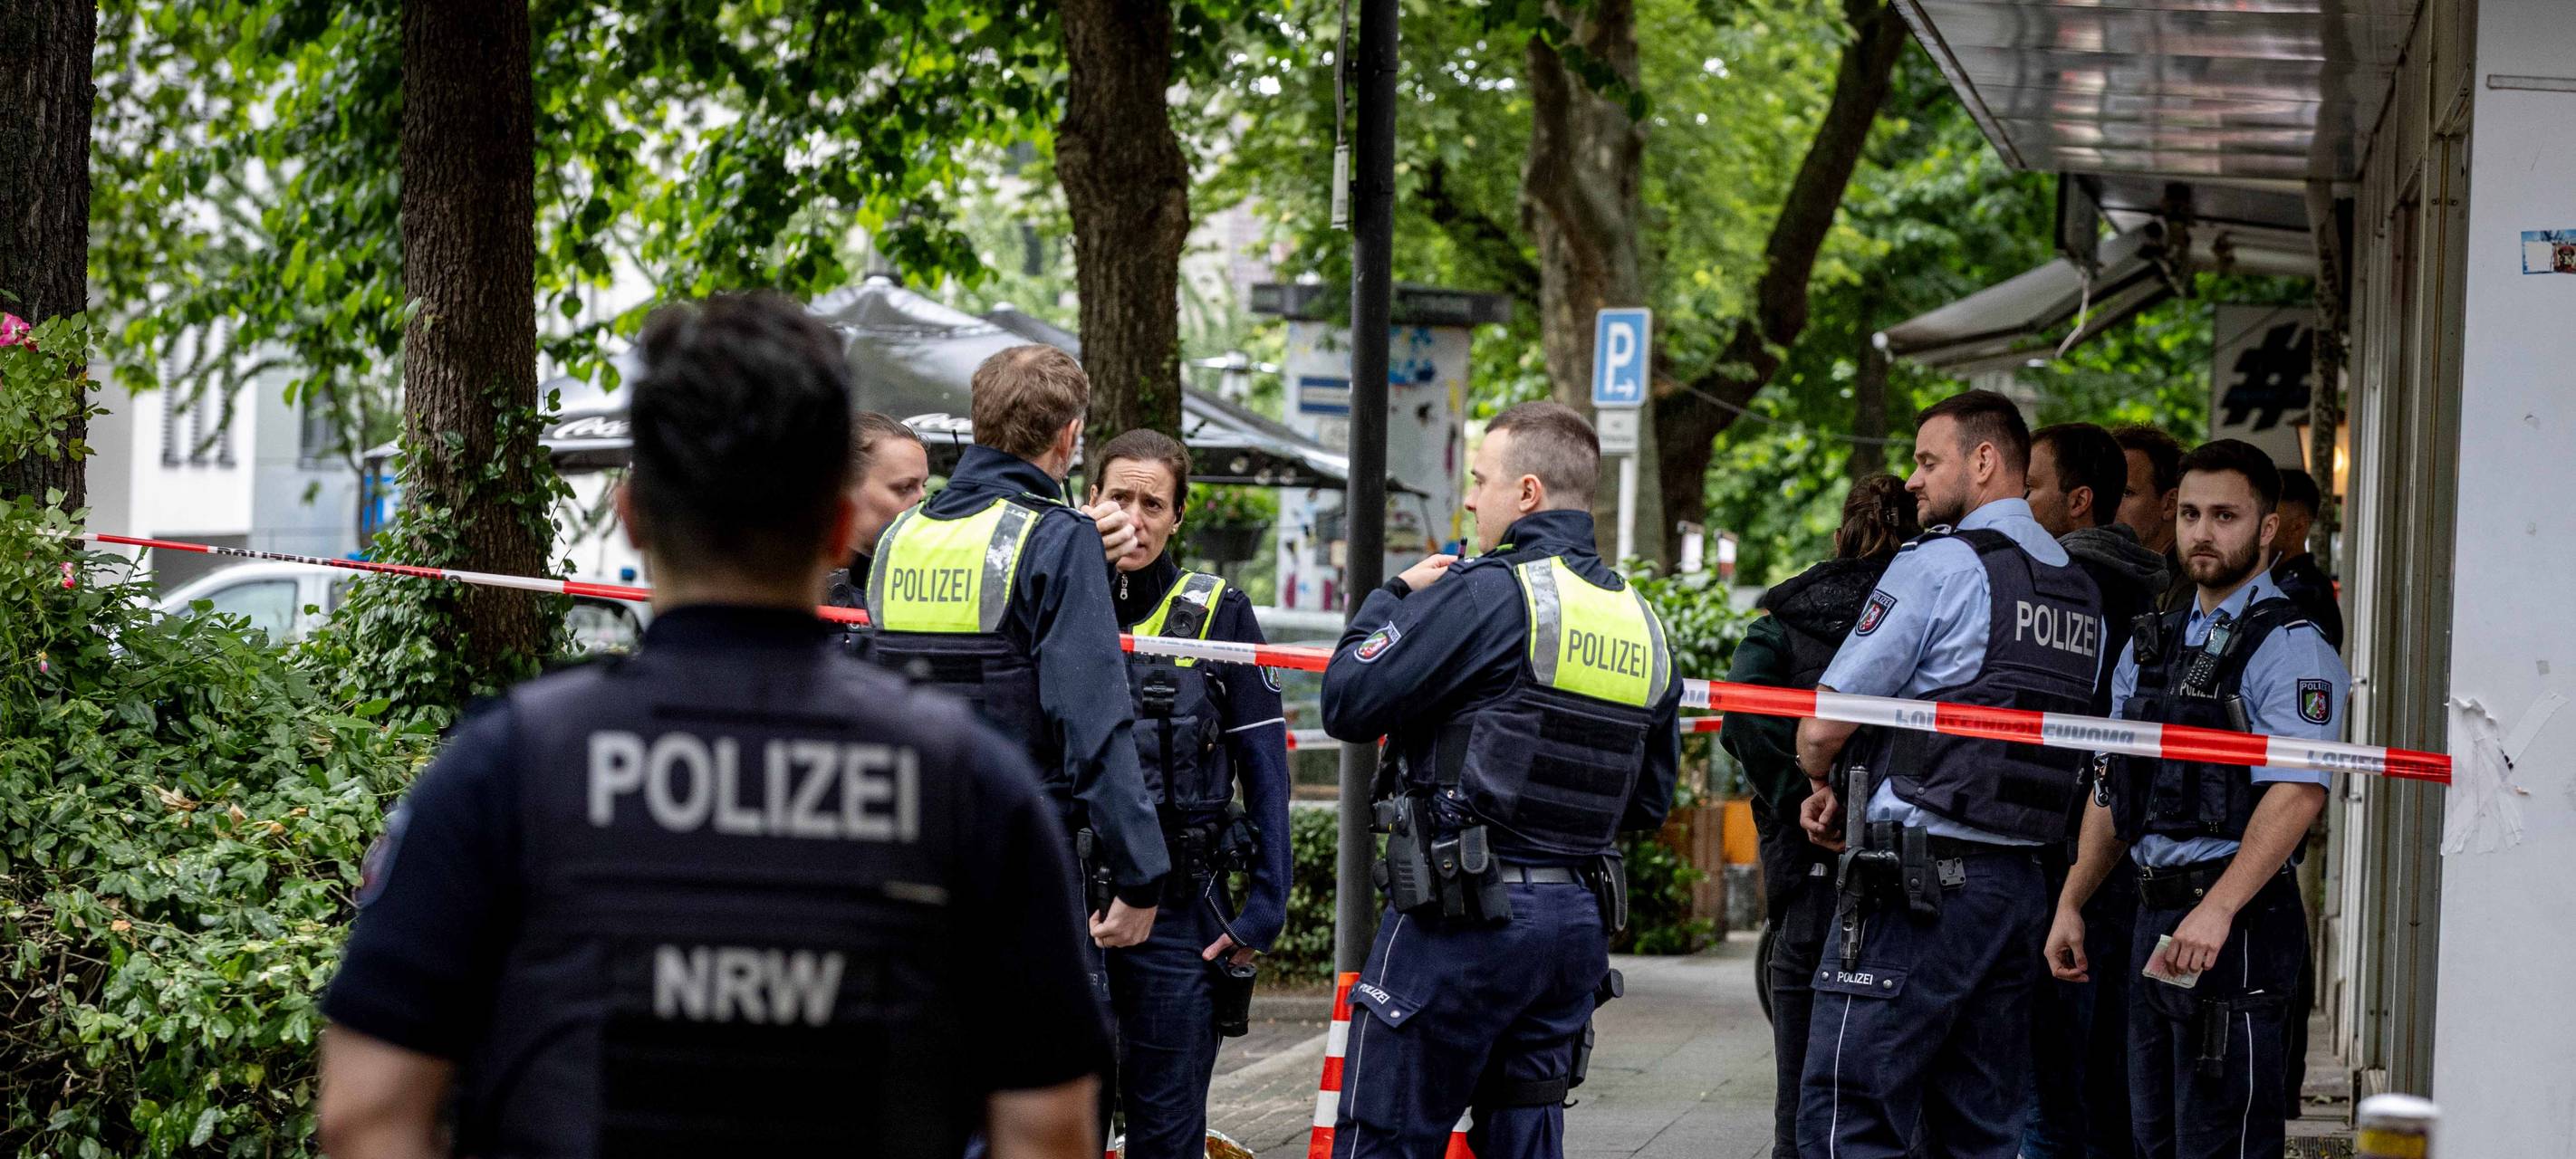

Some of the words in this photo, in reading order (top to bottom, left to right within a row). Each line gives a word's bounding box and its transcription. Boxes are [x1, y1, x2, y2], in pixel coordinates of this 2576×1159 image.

[1604, 321, 1635, 394] P
[890, 567, 972, 602] POLIZEI
[1567, 628, 1647, 679] POLIZEI
[2015, 600, 2098, 658] POLIZEI
[587, 730, 921, 844] POLIZEI
[654, 943, 847, 1027] NRW
[1837, 971, 1873, 985] POLIZEI
